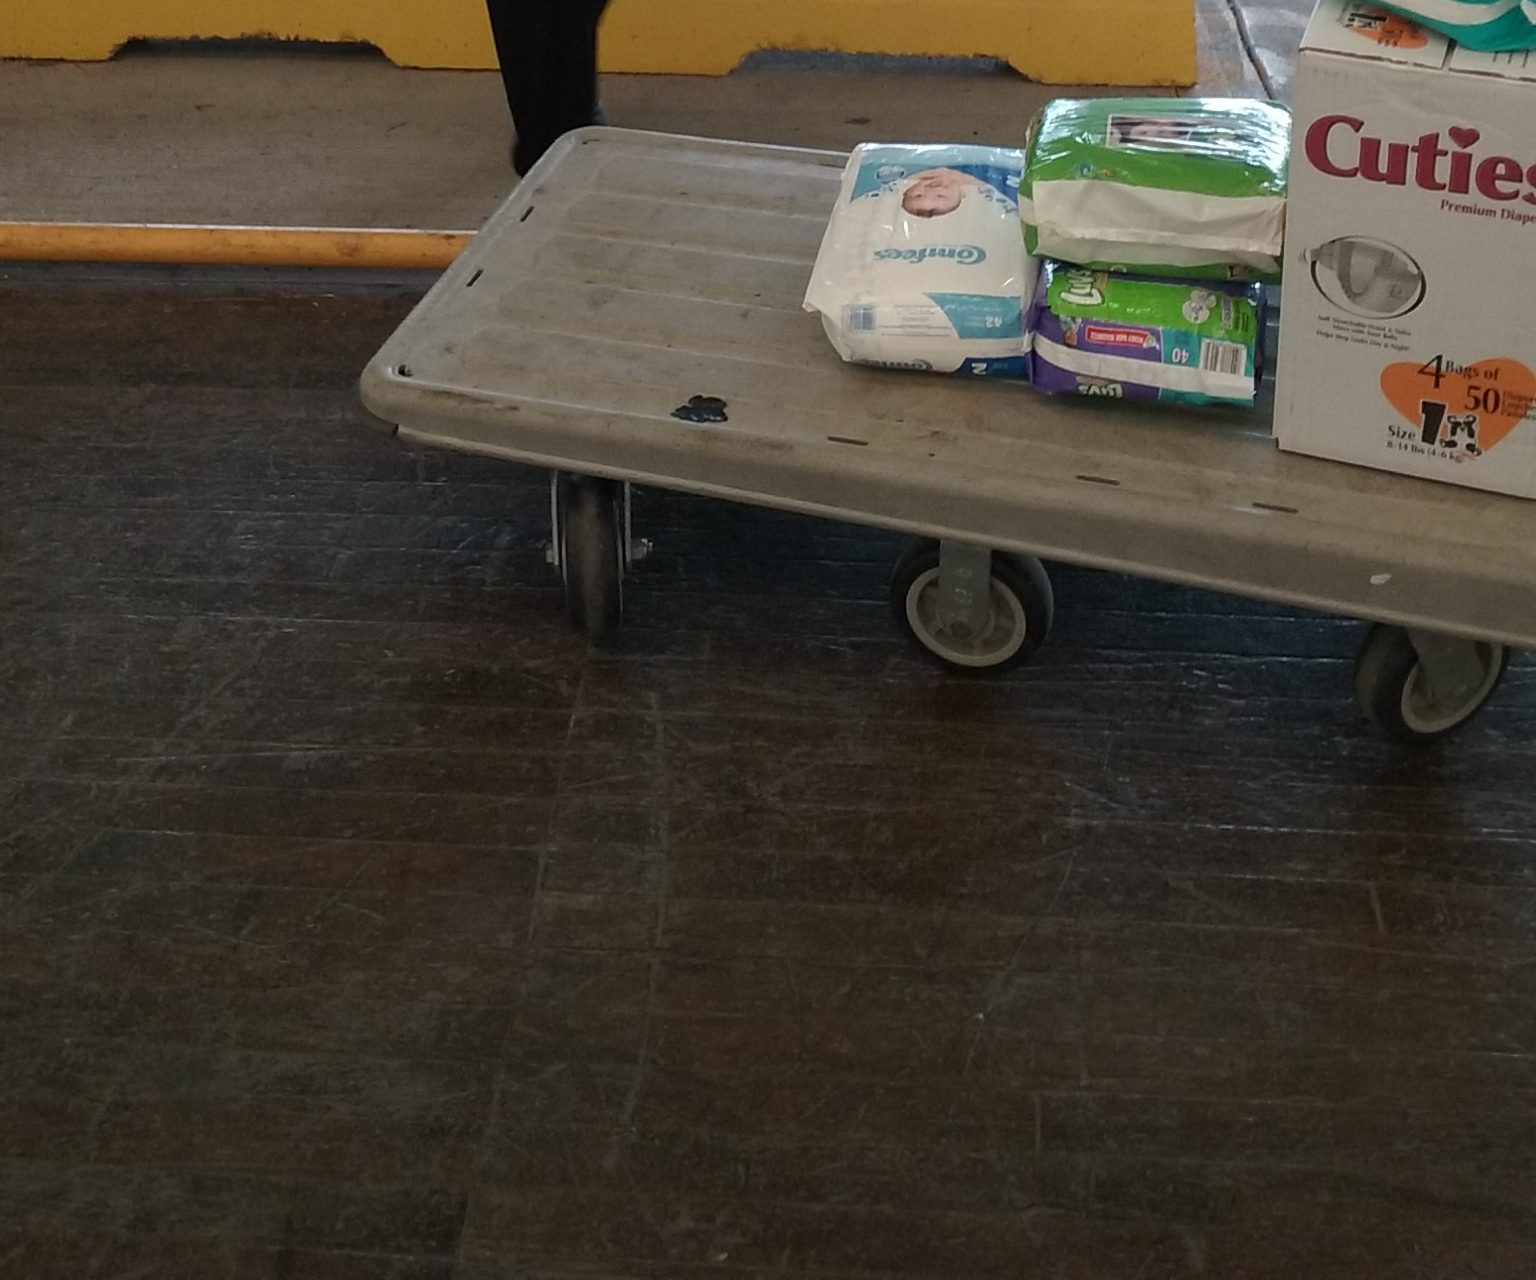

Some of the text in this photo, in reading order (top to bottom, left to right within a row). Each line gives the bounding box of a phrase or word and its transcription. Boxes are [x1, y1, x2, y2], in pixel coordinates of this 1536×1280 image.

[1440, 199, 1497, 218] Premium
[1171, 348, 1190, 364] 40
[1417, 353, 1500, 390] 4 Bags of
[1464, 385, 1500, 414] 50
[1388, 424, 1416, 440] Size
